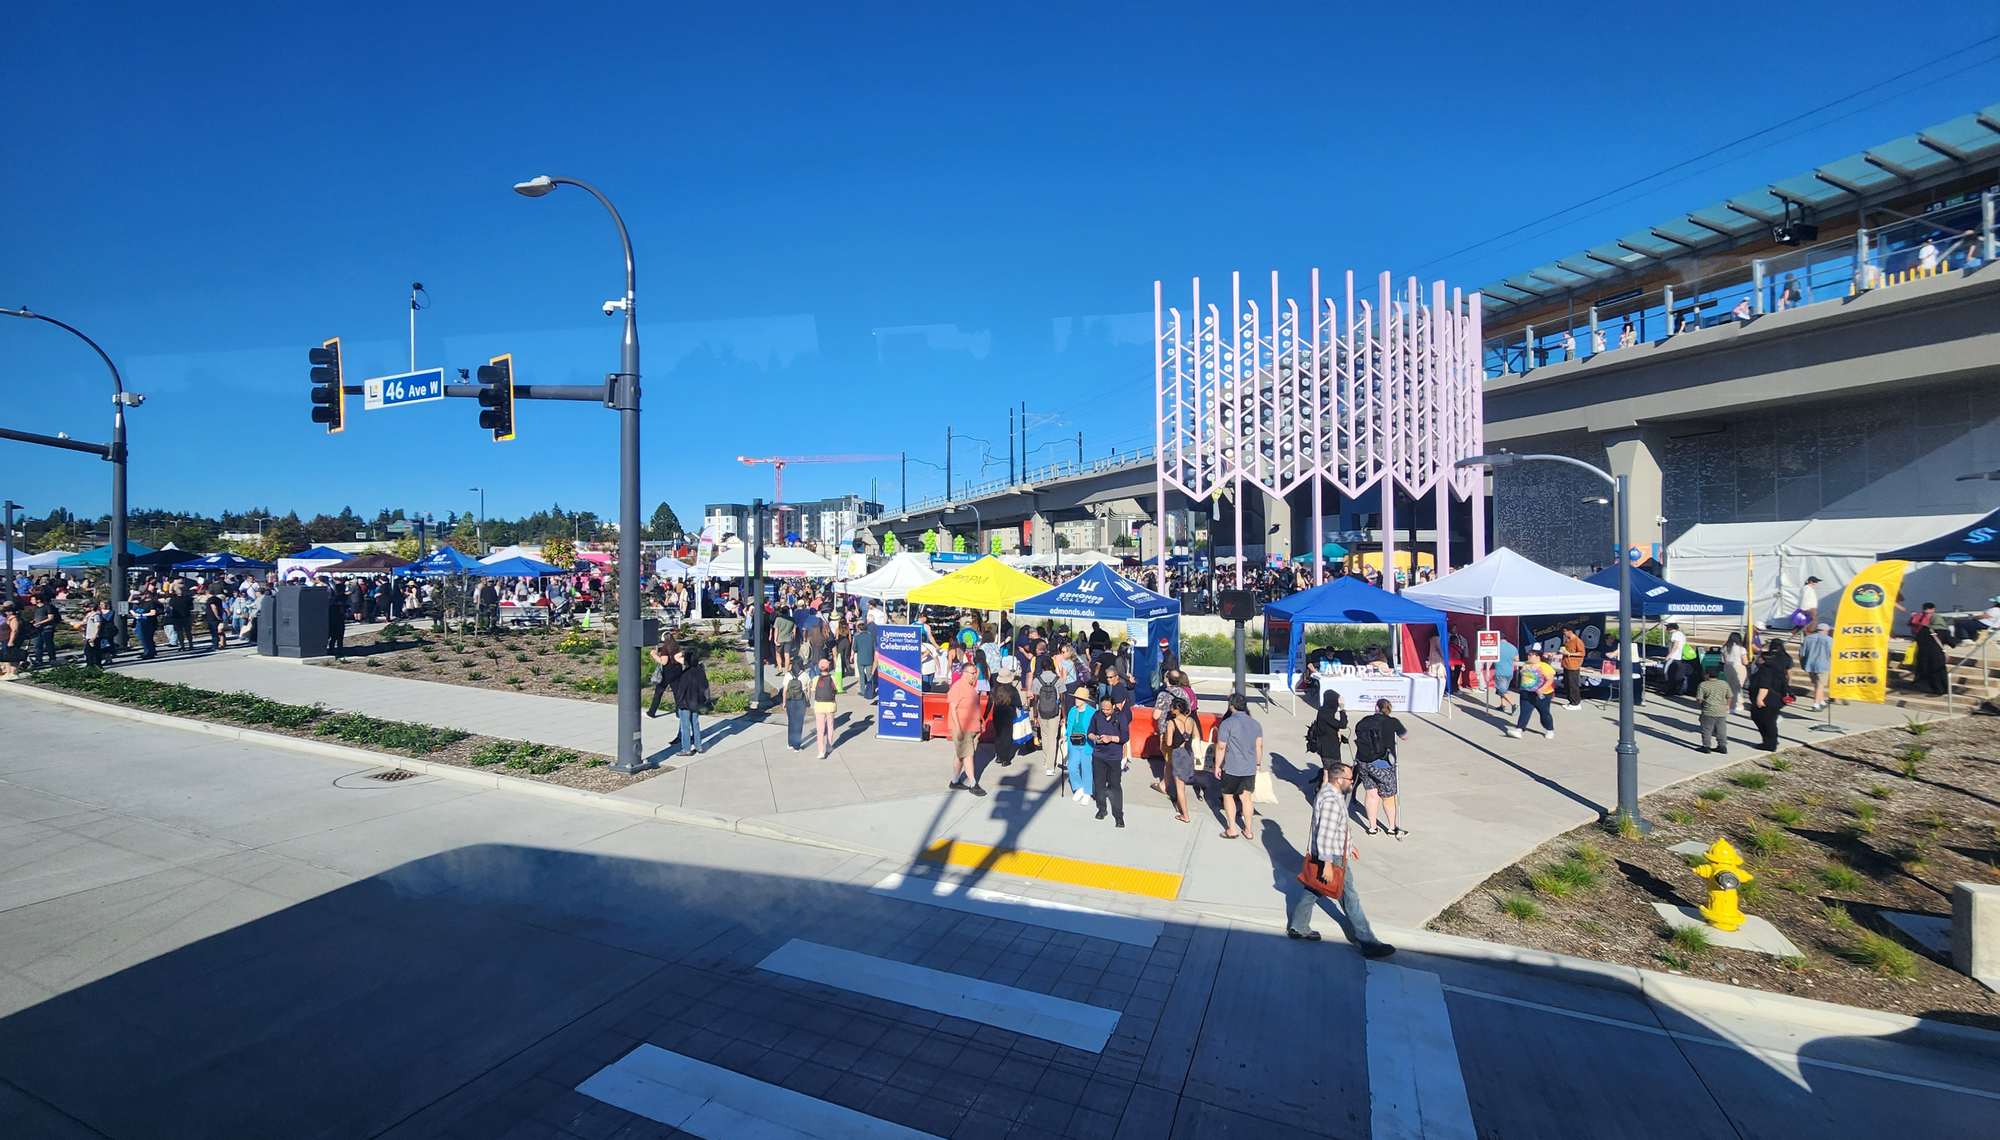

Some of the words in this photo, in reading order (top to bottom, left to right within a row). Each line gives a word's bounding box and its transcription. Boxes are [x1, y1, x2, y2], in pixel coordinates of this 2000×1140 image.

[385, 381, 405, 400] 46
[408, 384, 427, 398] Ave
[429, 380, 439, 395] W
[1056, 597, 1101, 605] COLLEGE
[1058, 592, 1104, 601] EDMONDS
[1049, 606, 1096, 616] edmonds.edu
[1667, 603, 1723, 612] KRKORADIO.COM
[882, 629, 916, 639] Lynnwood
[880, 642, 919, 651] Celebration
[1838, 650, 1880, 660] KRKO
[1836, 675, 1879, 685] KRKO
